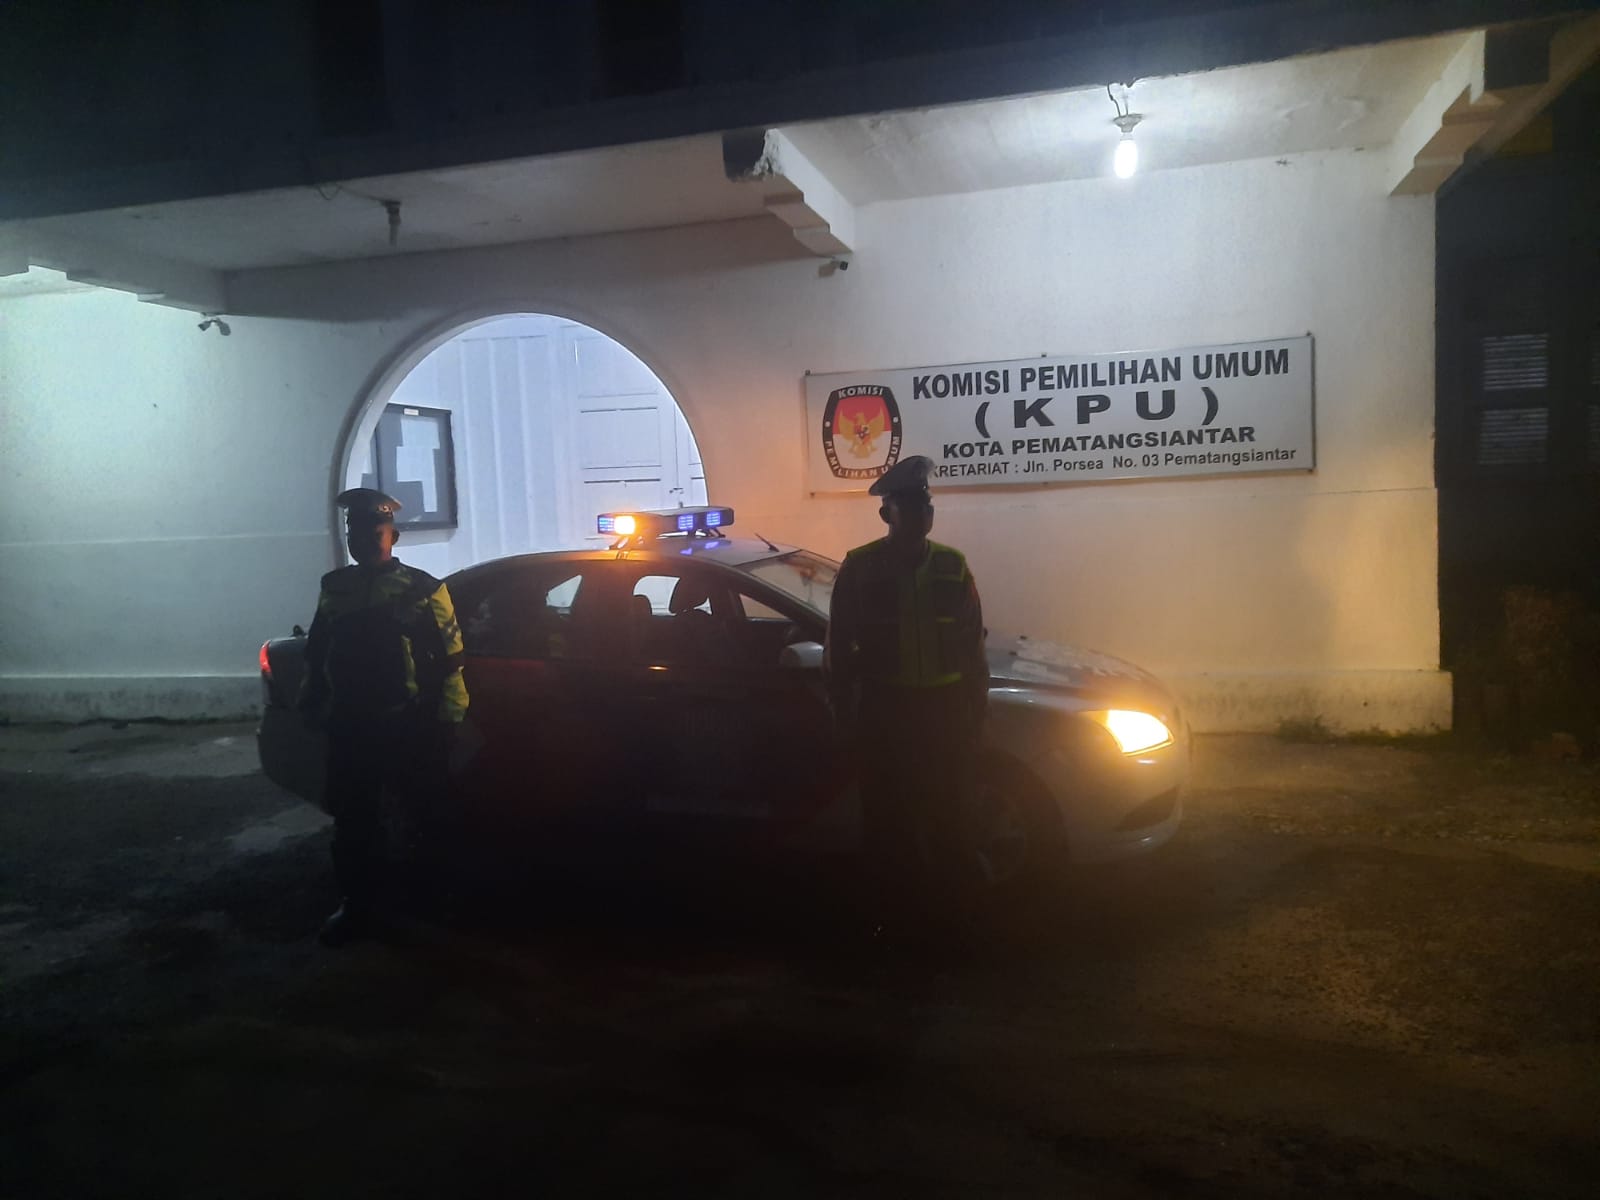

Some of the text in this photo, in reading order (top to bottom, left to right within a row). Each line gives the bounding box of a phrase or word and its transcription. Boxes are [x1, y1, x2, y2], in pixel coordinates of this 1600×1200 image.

[912, 348, 1289, 400] KOMISI PEMILIHAN UMUM
[838, 386, 885, 399] KOMISI
[824, 440, 878, 477] PEMILIHAN
[943, 426, 1256, 459] KOTA PEMATANGSIANTAR
[1023, 460, 1049, 474] Jln.
[1053, 458, 1104, 472] Porsea
[1112, 455, 1137, 469] No.
[1142, 453, 1160, 467] 03
[1164, 448, 1297, 466] Pematangsiantar
